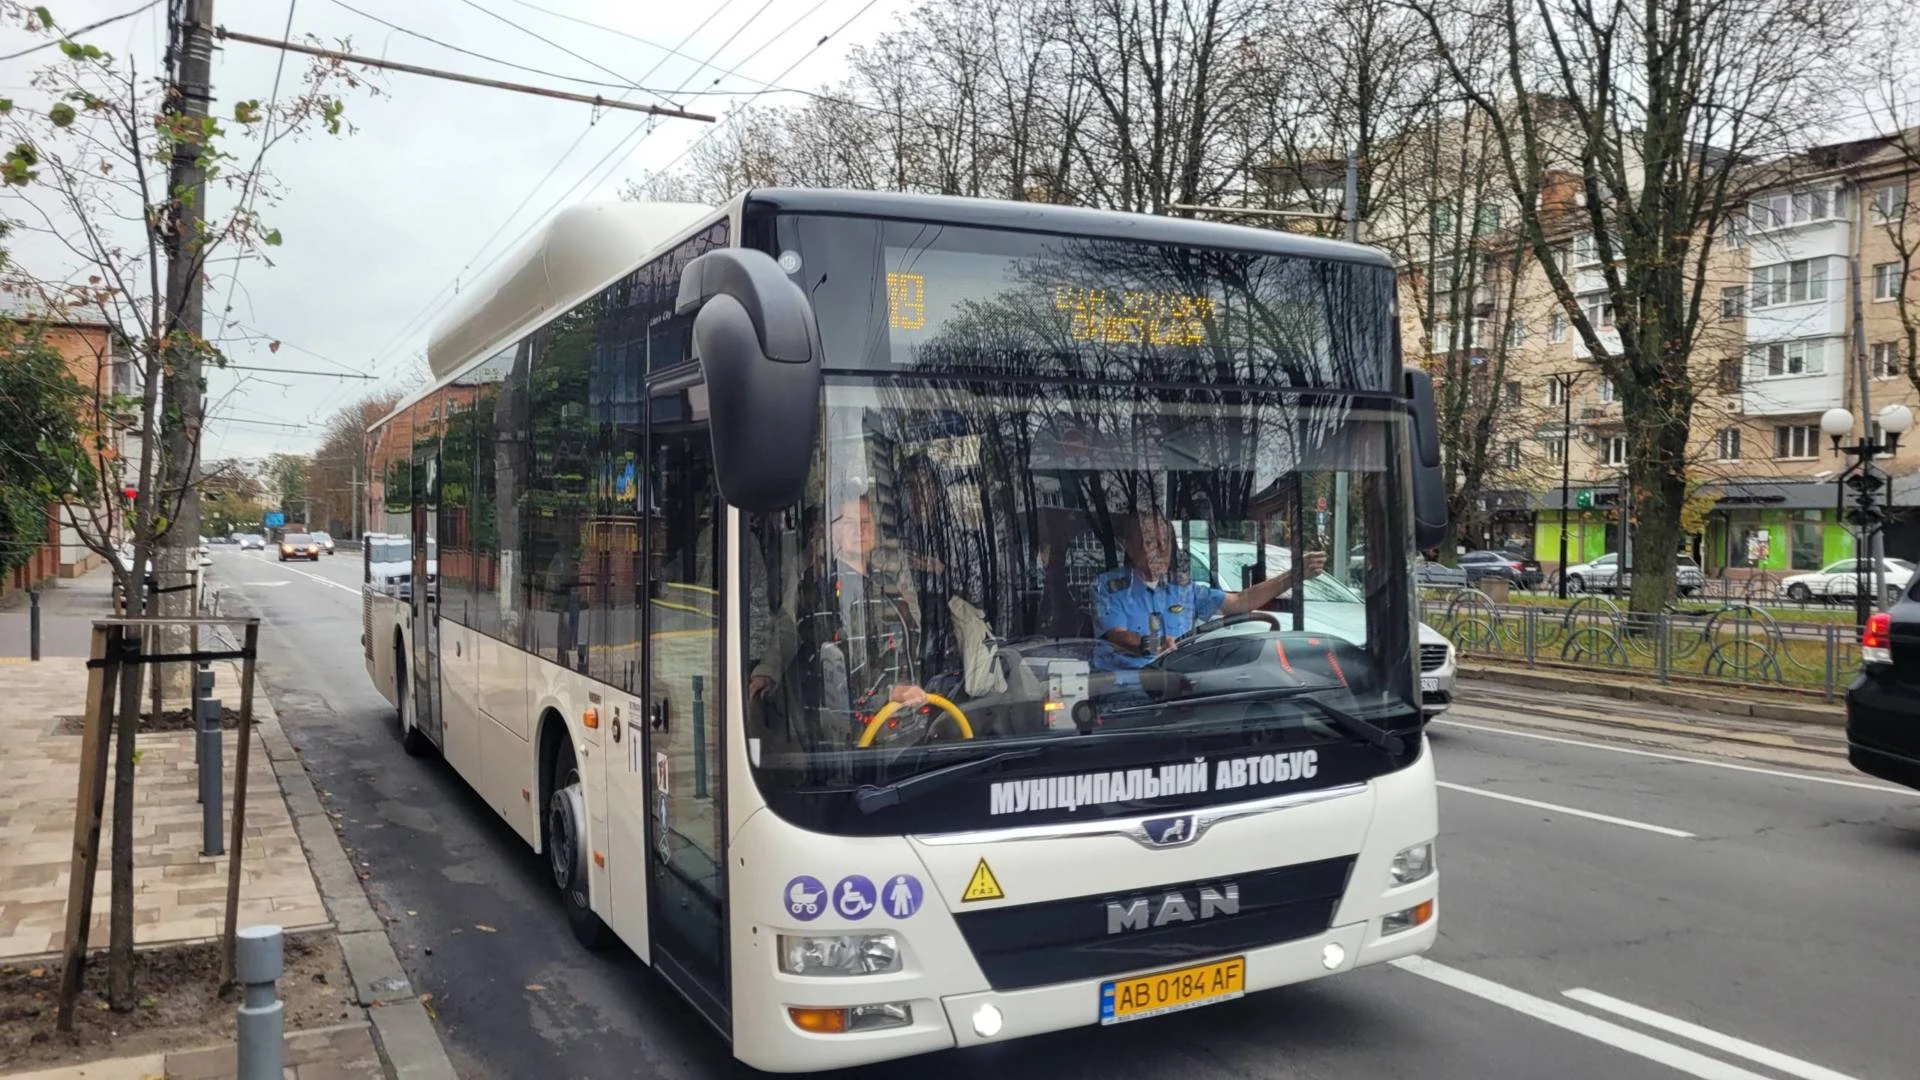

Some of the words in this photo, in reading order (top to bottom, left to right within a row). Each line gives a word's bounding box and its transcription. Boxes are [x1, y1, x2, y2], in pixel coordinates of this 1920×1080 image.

[887, 272, 924, 329] 19
[990, 757, 1208, 815] МУНІЦИПАЛЬНИЙ
[1215, 750, 1318, 790] АВТОБУС
[1107, 885, 1240, 934] MAN
[1119, 983, 1150, 1011] AB
[1157, 971, 1205, 1003] 0184
[1212, 964, 1240, 992] AF
